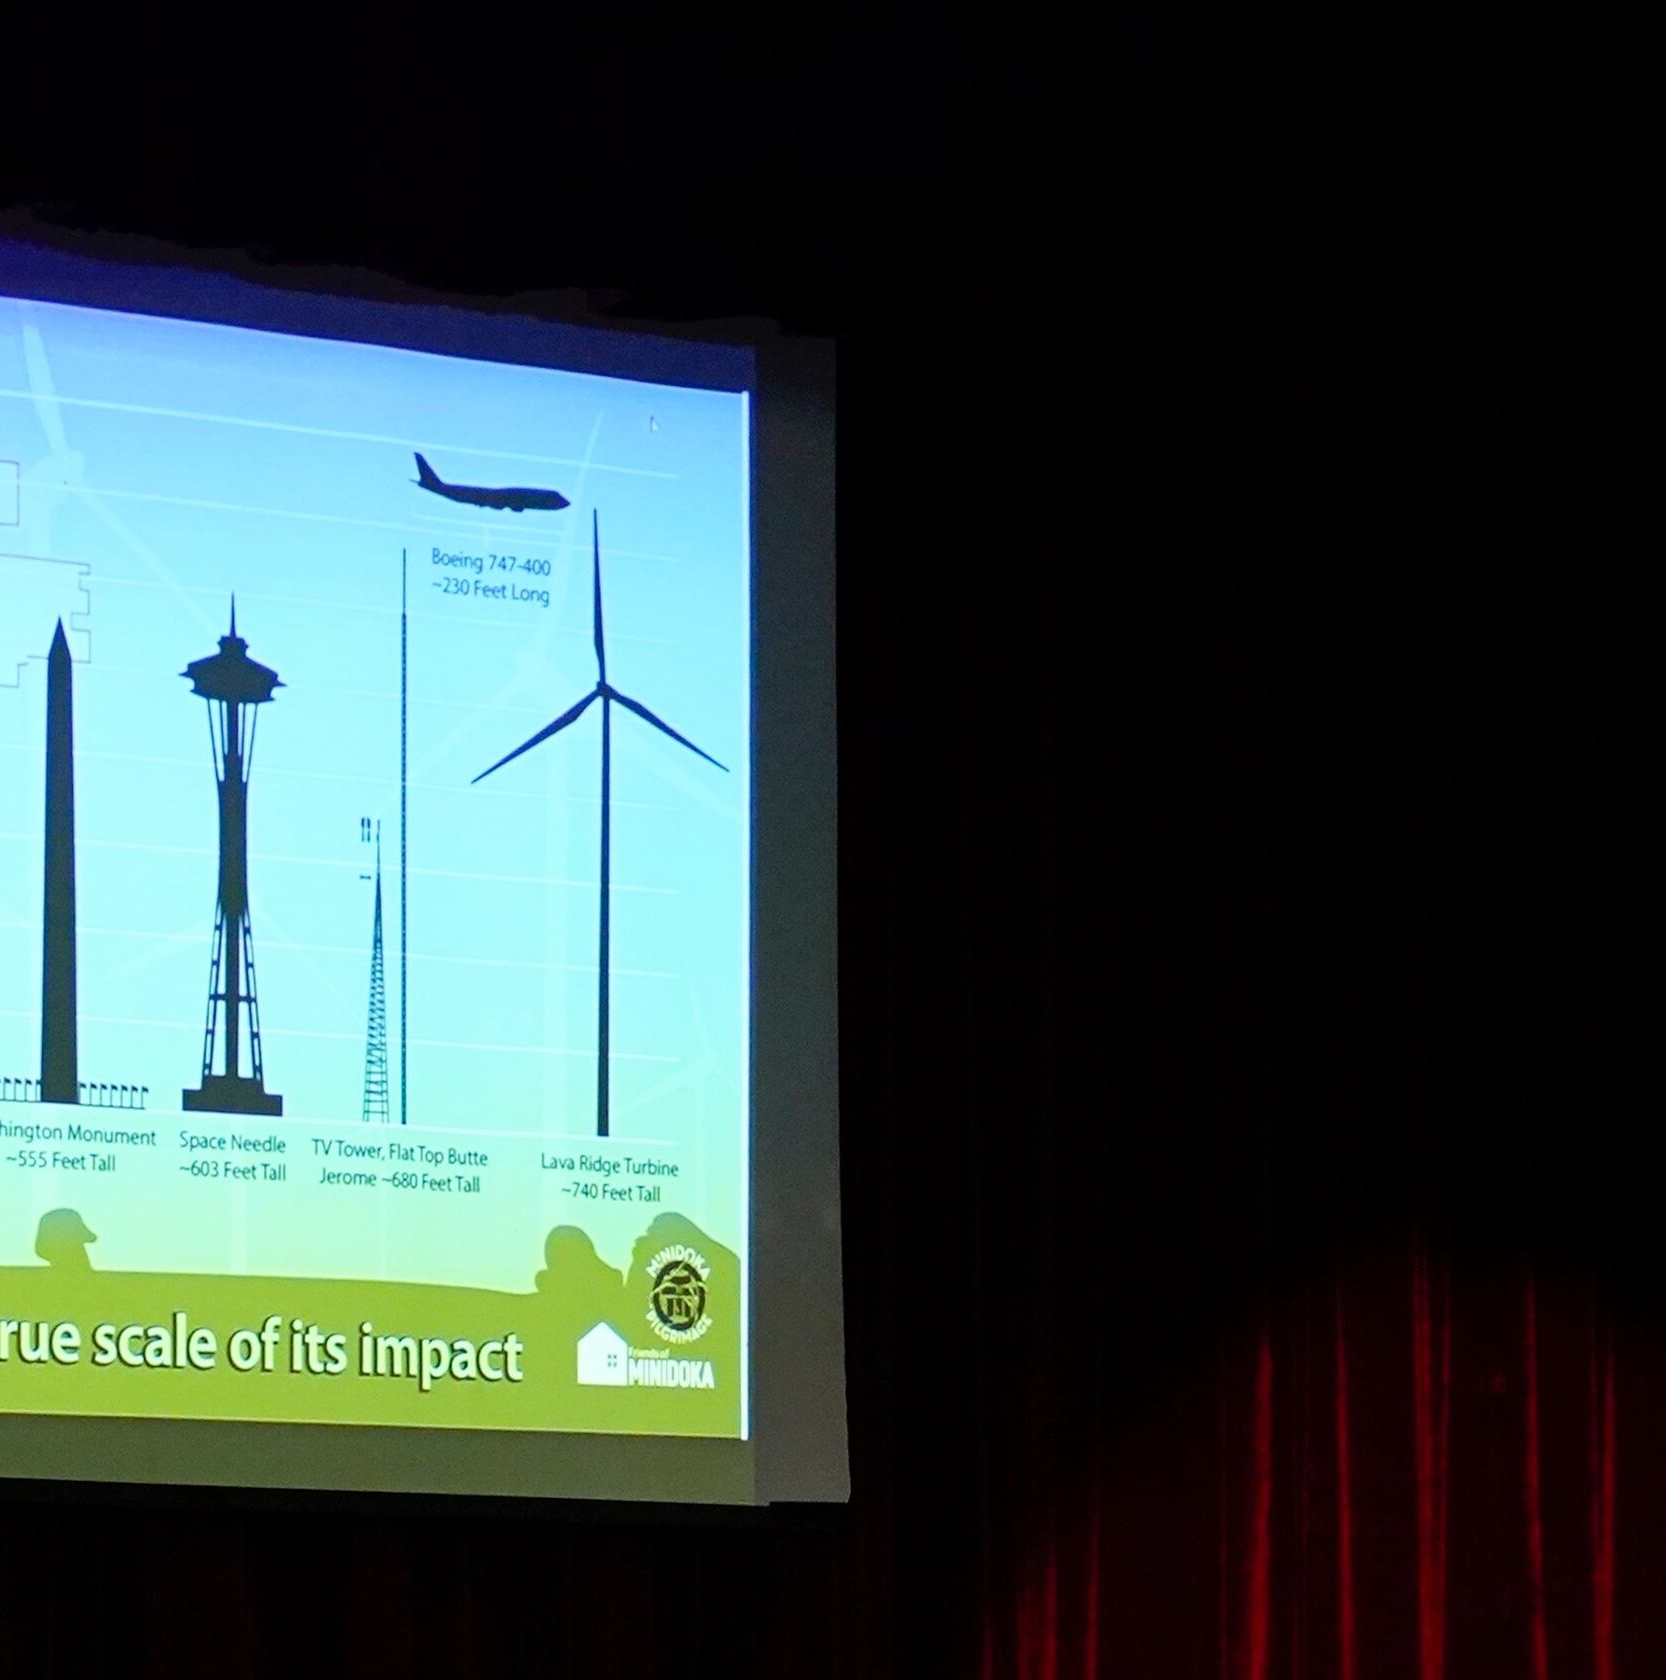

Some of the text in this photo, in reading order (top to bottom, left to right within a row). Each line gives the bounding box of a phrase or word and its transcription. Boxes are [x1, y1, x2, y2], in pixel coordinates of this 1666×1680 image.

[431, 547, 552, 577] Boeing 747-400
[473, 579, 507, 600] Feet
[511, 583, 550, 609] Long
[67, 1123, 157, 1147] Monument
[179, 1130, 286, 1154] Space Needle
[52, 1151, 86, 1171] Feet
[89, 1153, 116, 1172] Tall
[311, 1138, 489, 1168] TV Tower, Flat Top Butte
[541, 1152, 679, 1178] Lava Ridge Turbine
[223, 1160, 256, 1180] Feet
[260, 1162, 287, 1181] Tall
[319, 1167, 377, 1187] Jerome
[421, 1173, 452, 1193] Feet
[454, 1175, 481, 1193] Tall
[602, 1183, 633, 1202] Feet
[636, 1185, 661, 1203] Tall
[645, 1244, 711, 1281] MINIDOKA
[95, 1312, 217, 1367] scale
[230, 1316, 282, 1369] of
[293, 1320, 348, 1373] its
[362, 1322, 523, 1390] impact
[628, 1358, 715, 1389] MINIDOKA
